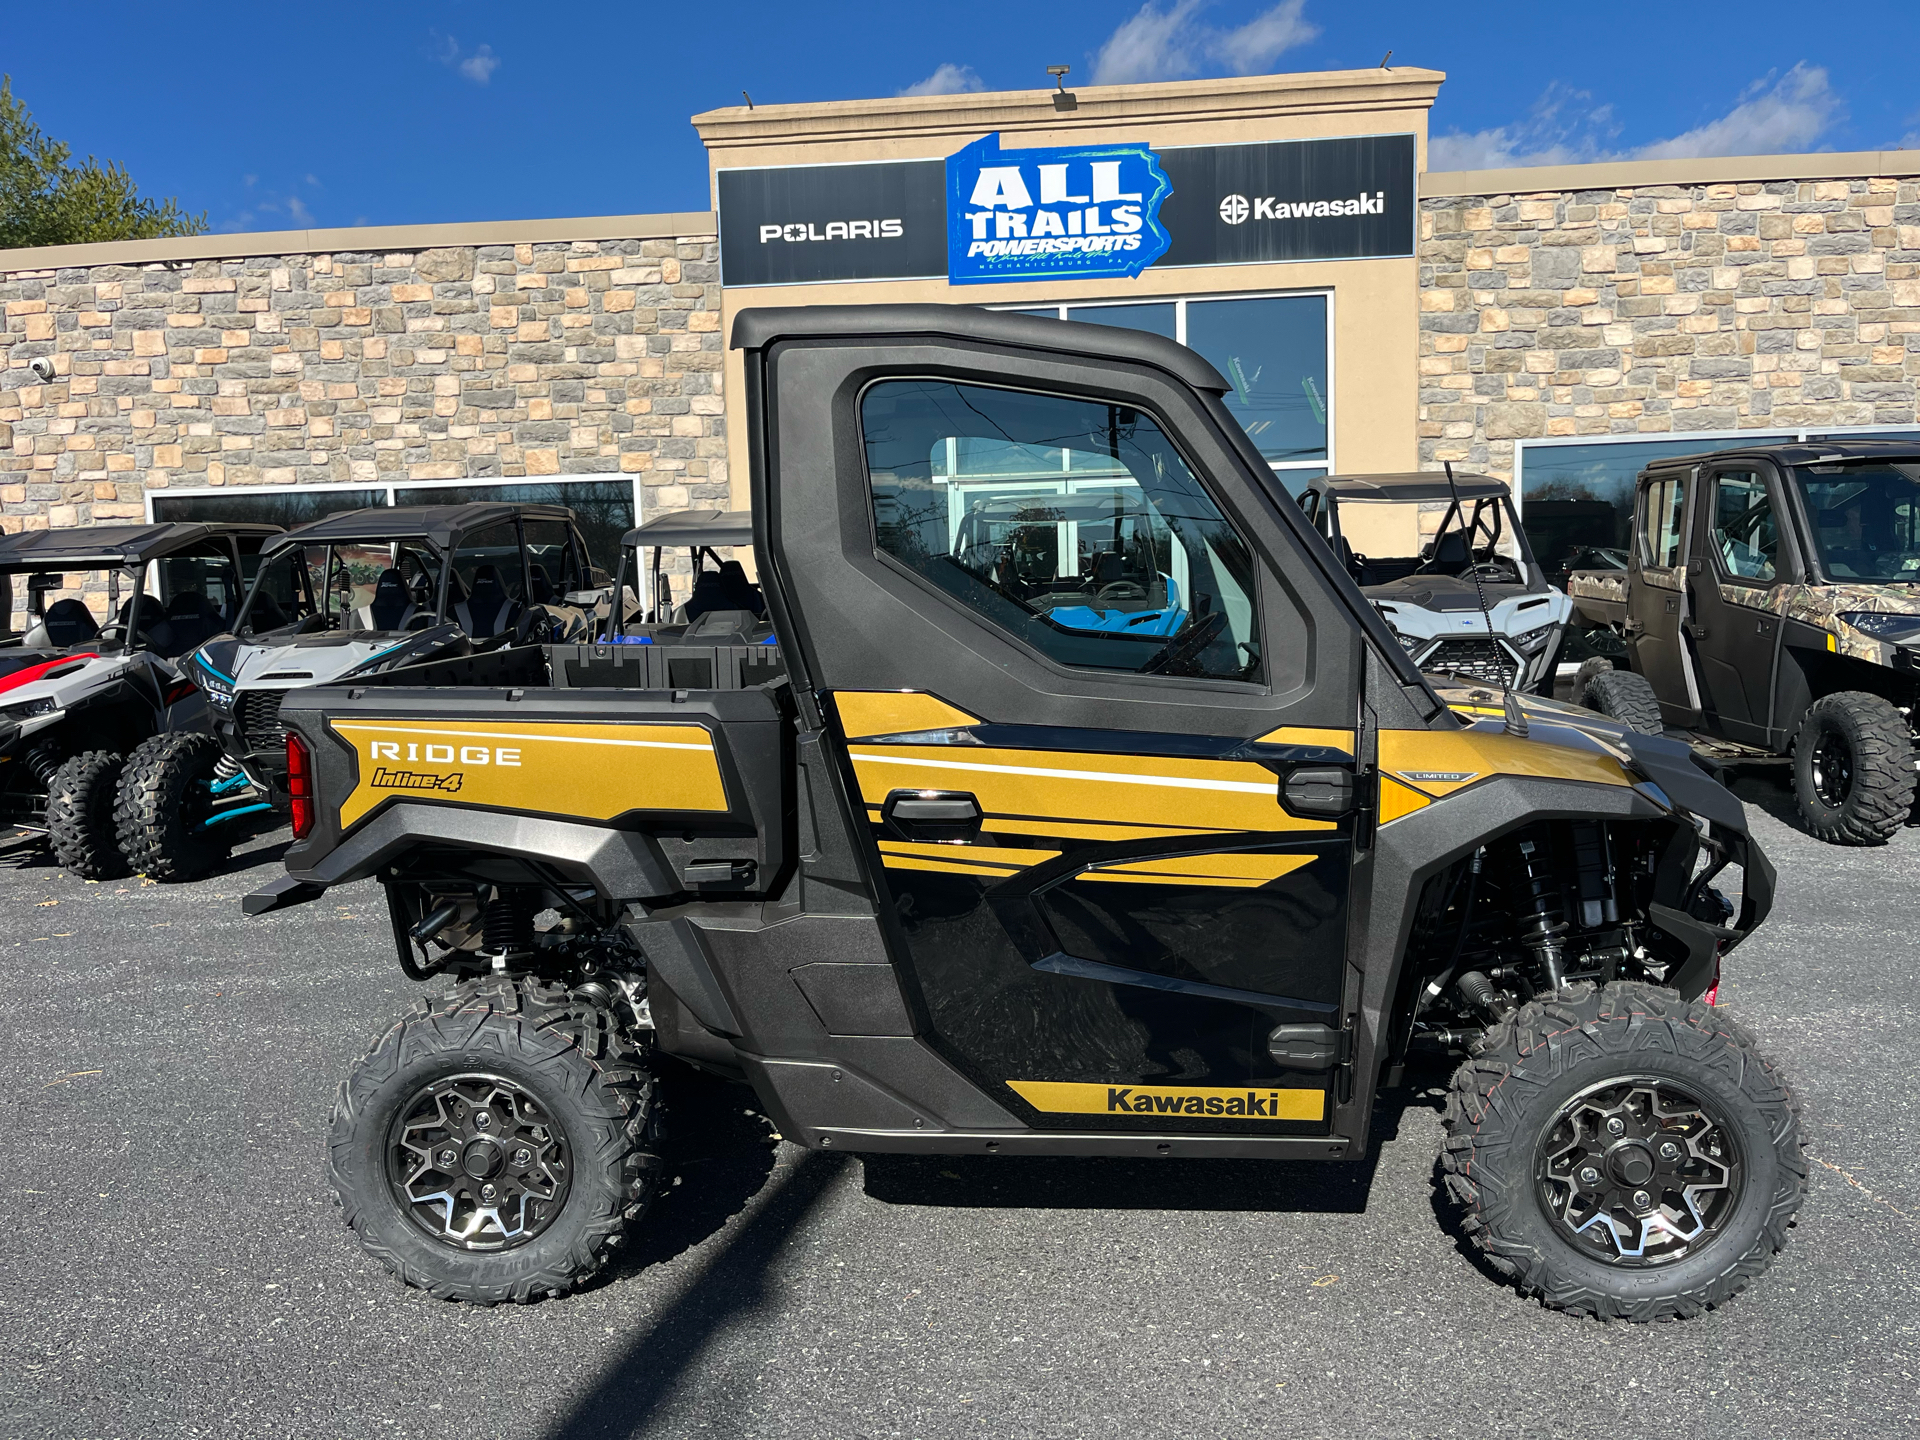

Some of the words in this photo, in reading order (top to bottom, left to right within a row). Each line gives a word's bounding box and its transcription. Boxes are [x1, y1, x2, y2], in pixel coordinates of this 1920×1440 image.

[969, 161, 1142, 210] ALL
[1254, 191, 1384, 220] Kawasaki
[760, 218, 903, 243] POLARIS
[965, 205, 1143, 239] TRAILS
[967, 234, 1142, 257] POWERSPORTS
[1233, 356, 1251, 393] Kawasaki
[1307, 376, 1326, 412] Kawasaki
[371, 741, 522, 766] RIDGE
[371, 767, 463, 792] Inline-4
[1107, 1088, 1278, 1116] Kawasaki
